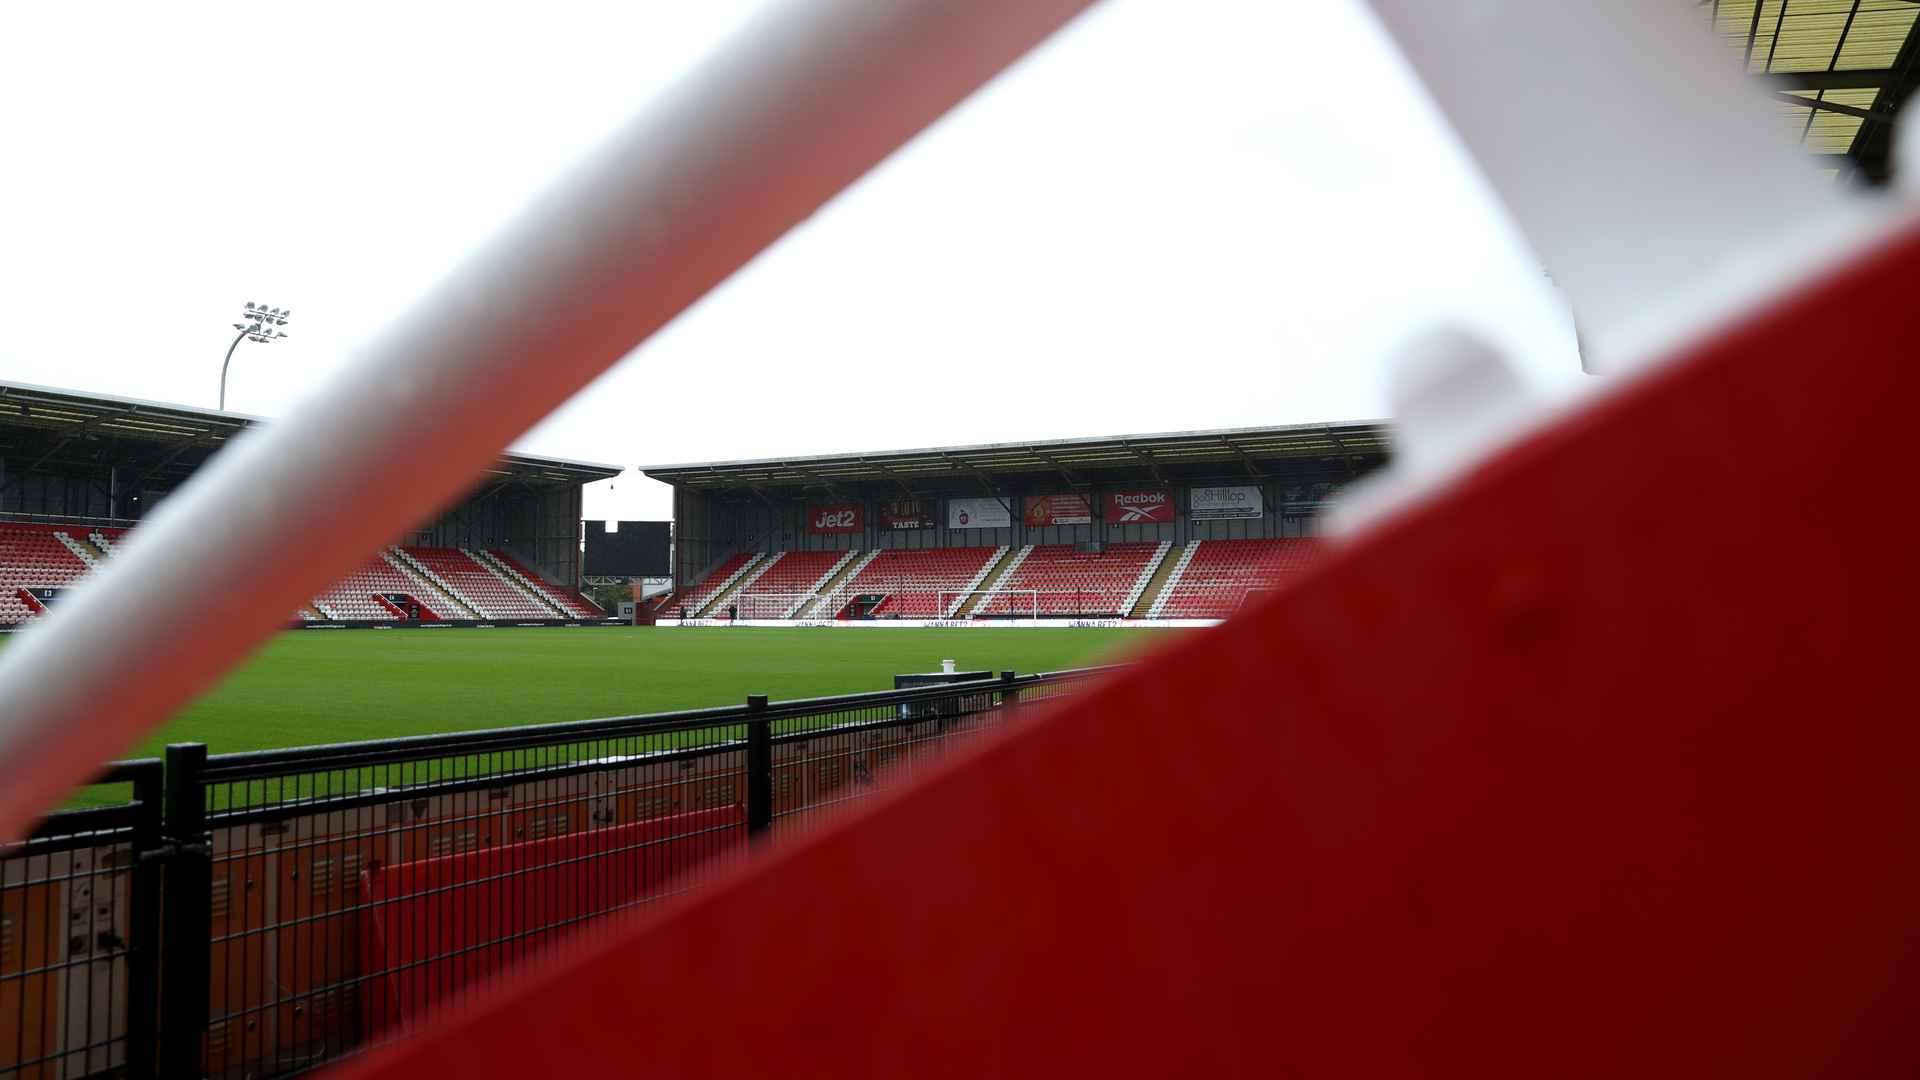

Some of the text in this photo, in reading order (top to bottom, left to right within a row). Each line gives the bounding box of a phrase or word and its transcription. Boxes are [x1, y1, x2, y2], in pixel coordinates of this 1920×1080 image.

[1114, 493, 1165, 504] Reebok
[815, 510, 855, 528] Jet2
[892, 520, 920, 529] TASTE
